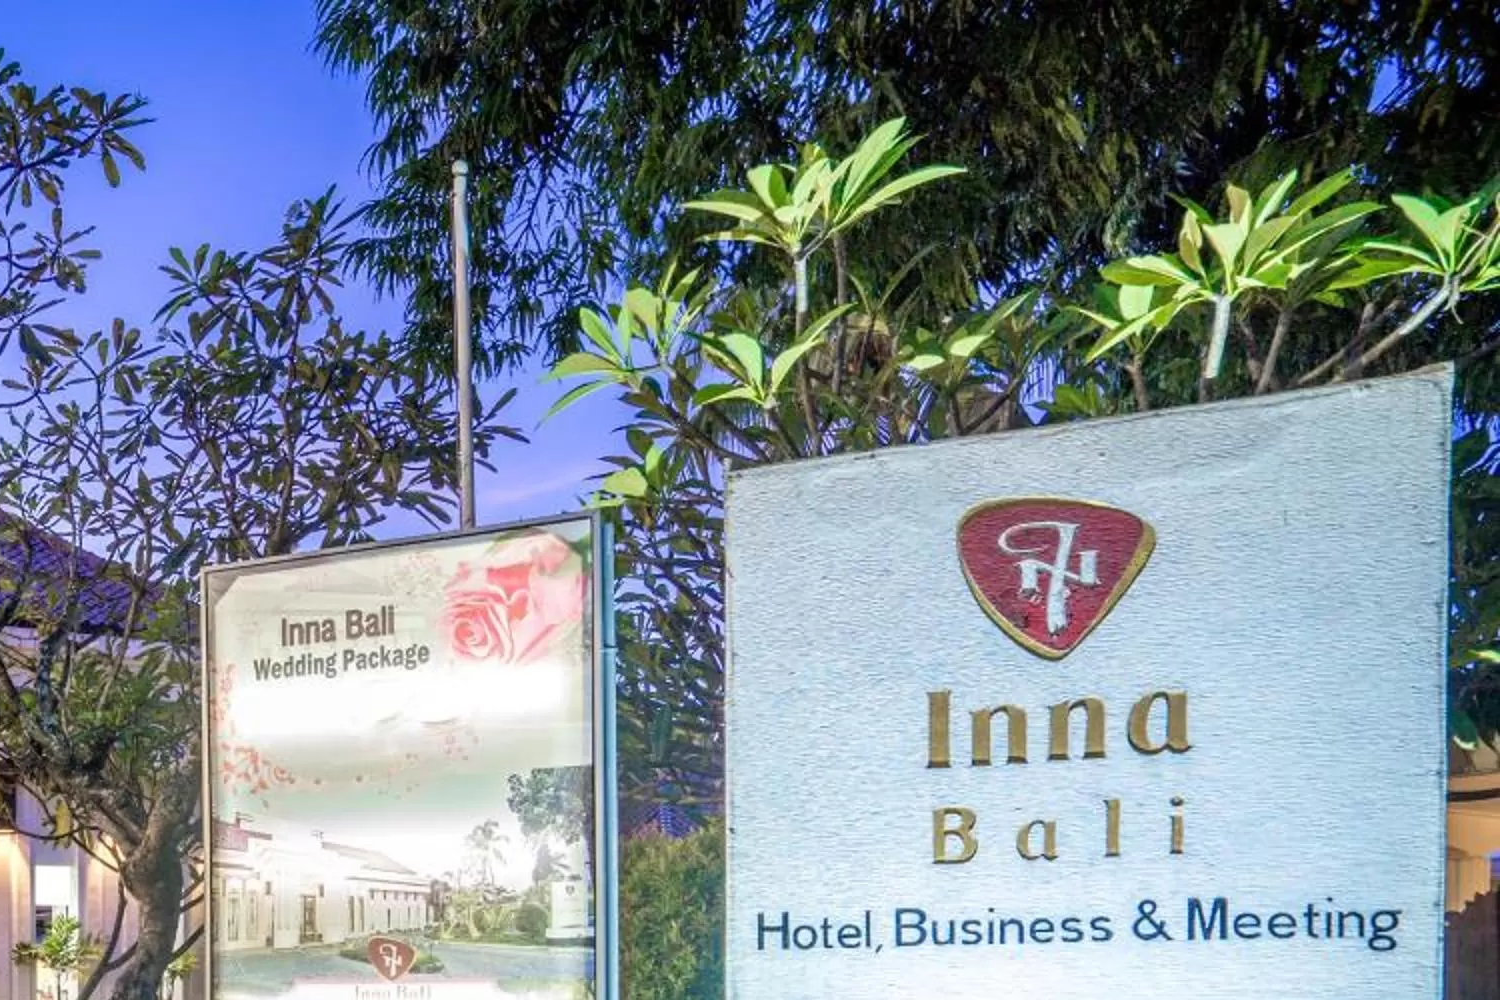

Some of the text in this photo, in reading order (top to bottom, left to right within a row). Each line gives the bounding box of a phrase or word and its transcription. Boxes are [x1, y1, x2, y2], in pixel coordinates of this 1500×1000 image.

[281, 604, 395, 647] Inna Bali
[253, 643, 430, 681] Wedding Package
[925, 688, 1192, 769] Inna
[932, 796, 1185, 865] Bali
[757, 897, 1402, 954] Hotel, Business & Meeting
